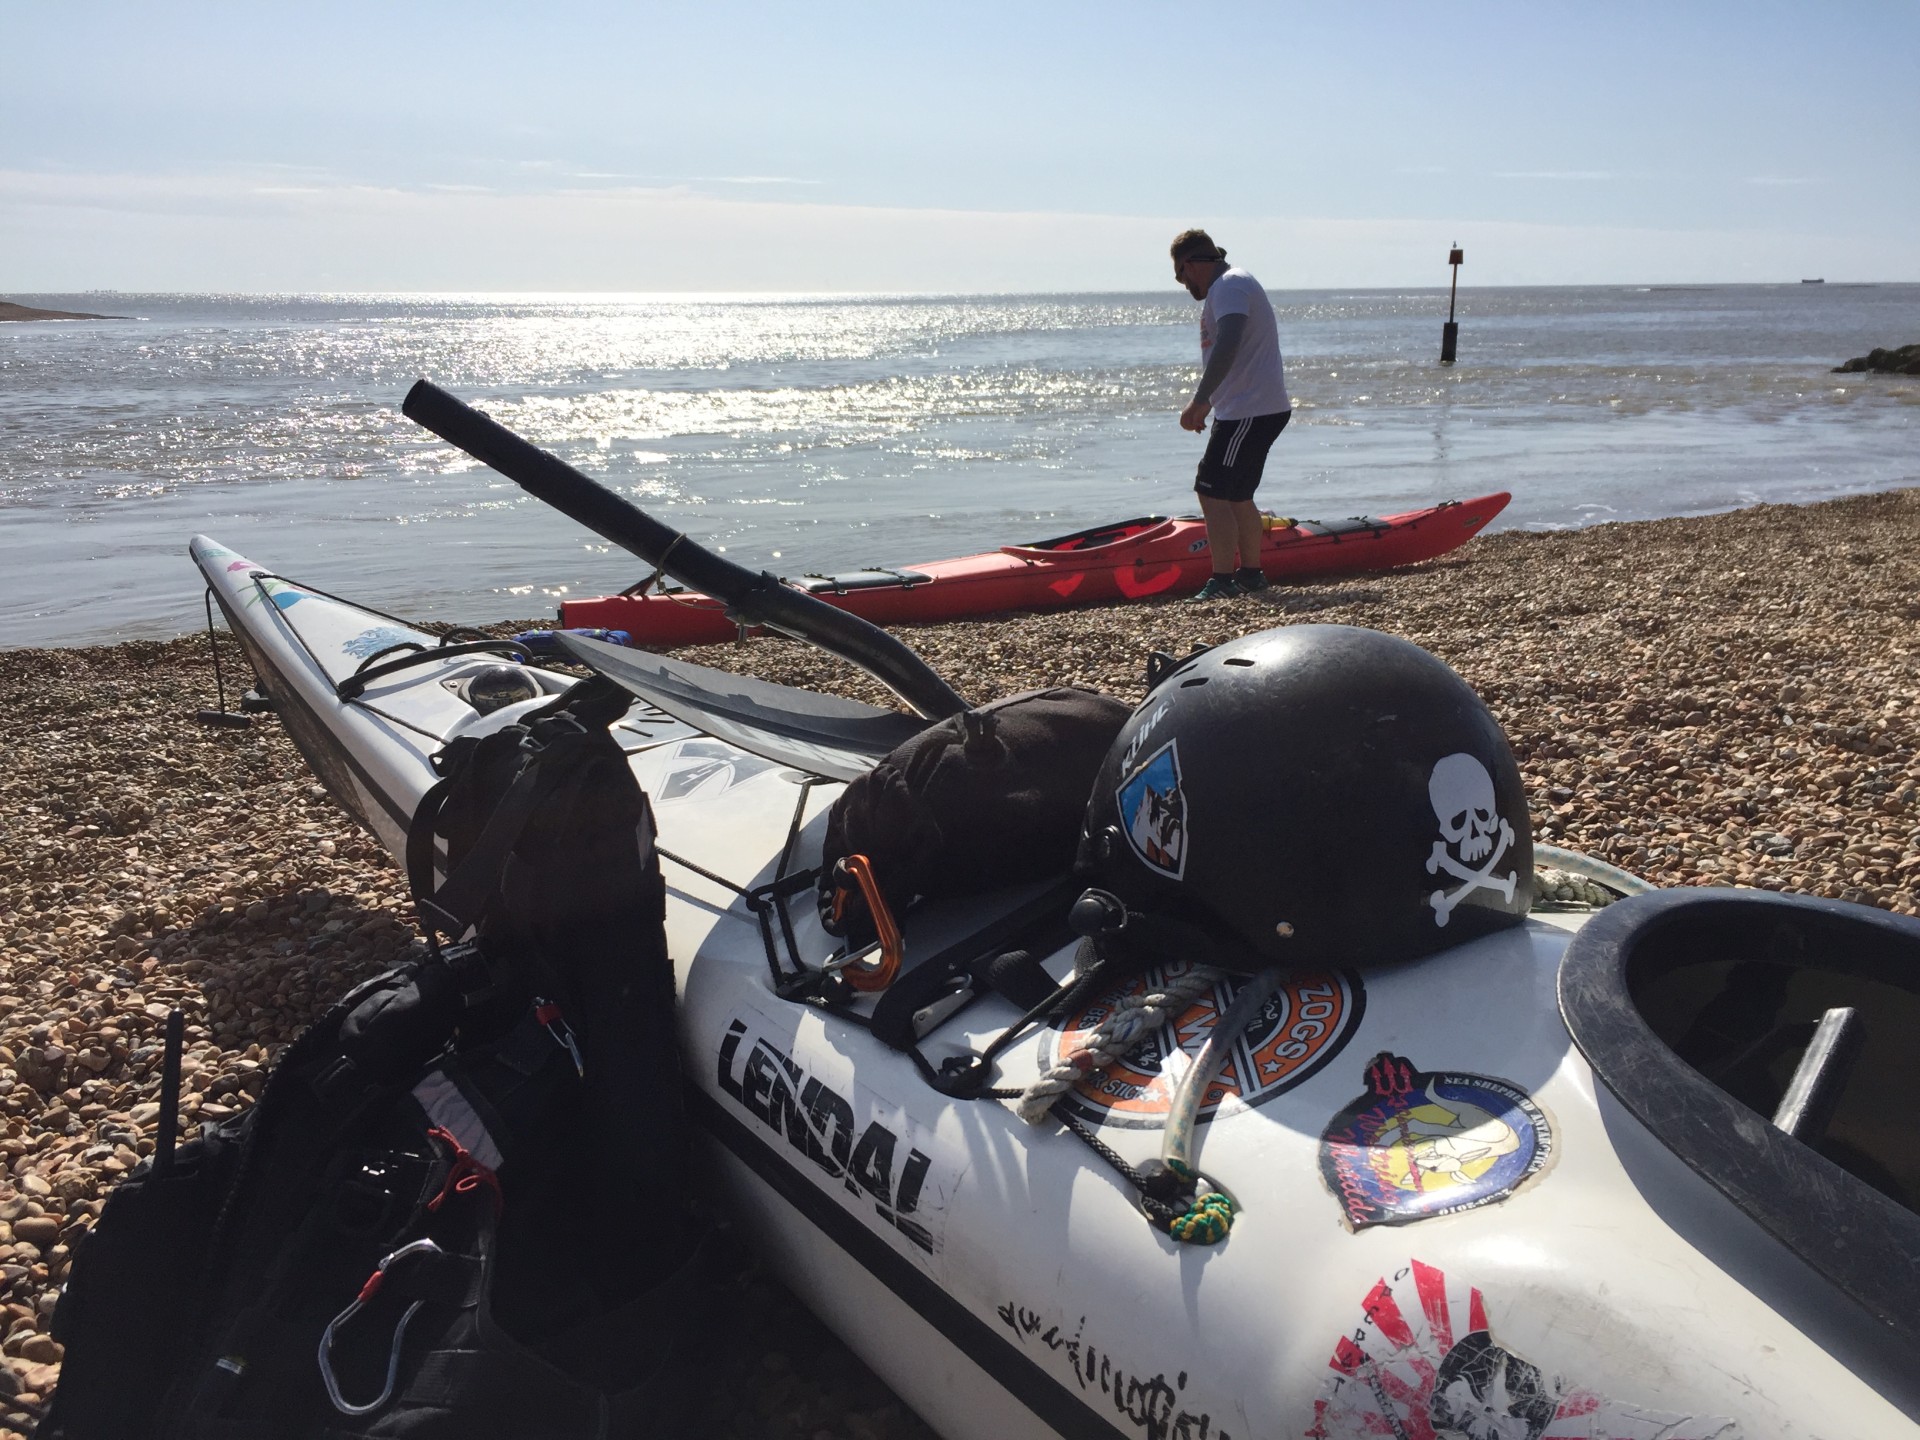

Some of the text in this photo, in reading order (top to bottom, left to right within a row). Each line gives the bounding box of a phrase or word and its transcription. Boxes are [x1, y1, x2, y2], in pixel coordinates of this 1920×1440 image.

[1275, 982, 1335, 1060] ZOGS
[717, 1018, 934, 1256] LENDAL
[1444, 1076, 1552, 1173] SEA SHEPHERD ANTARCTICA
